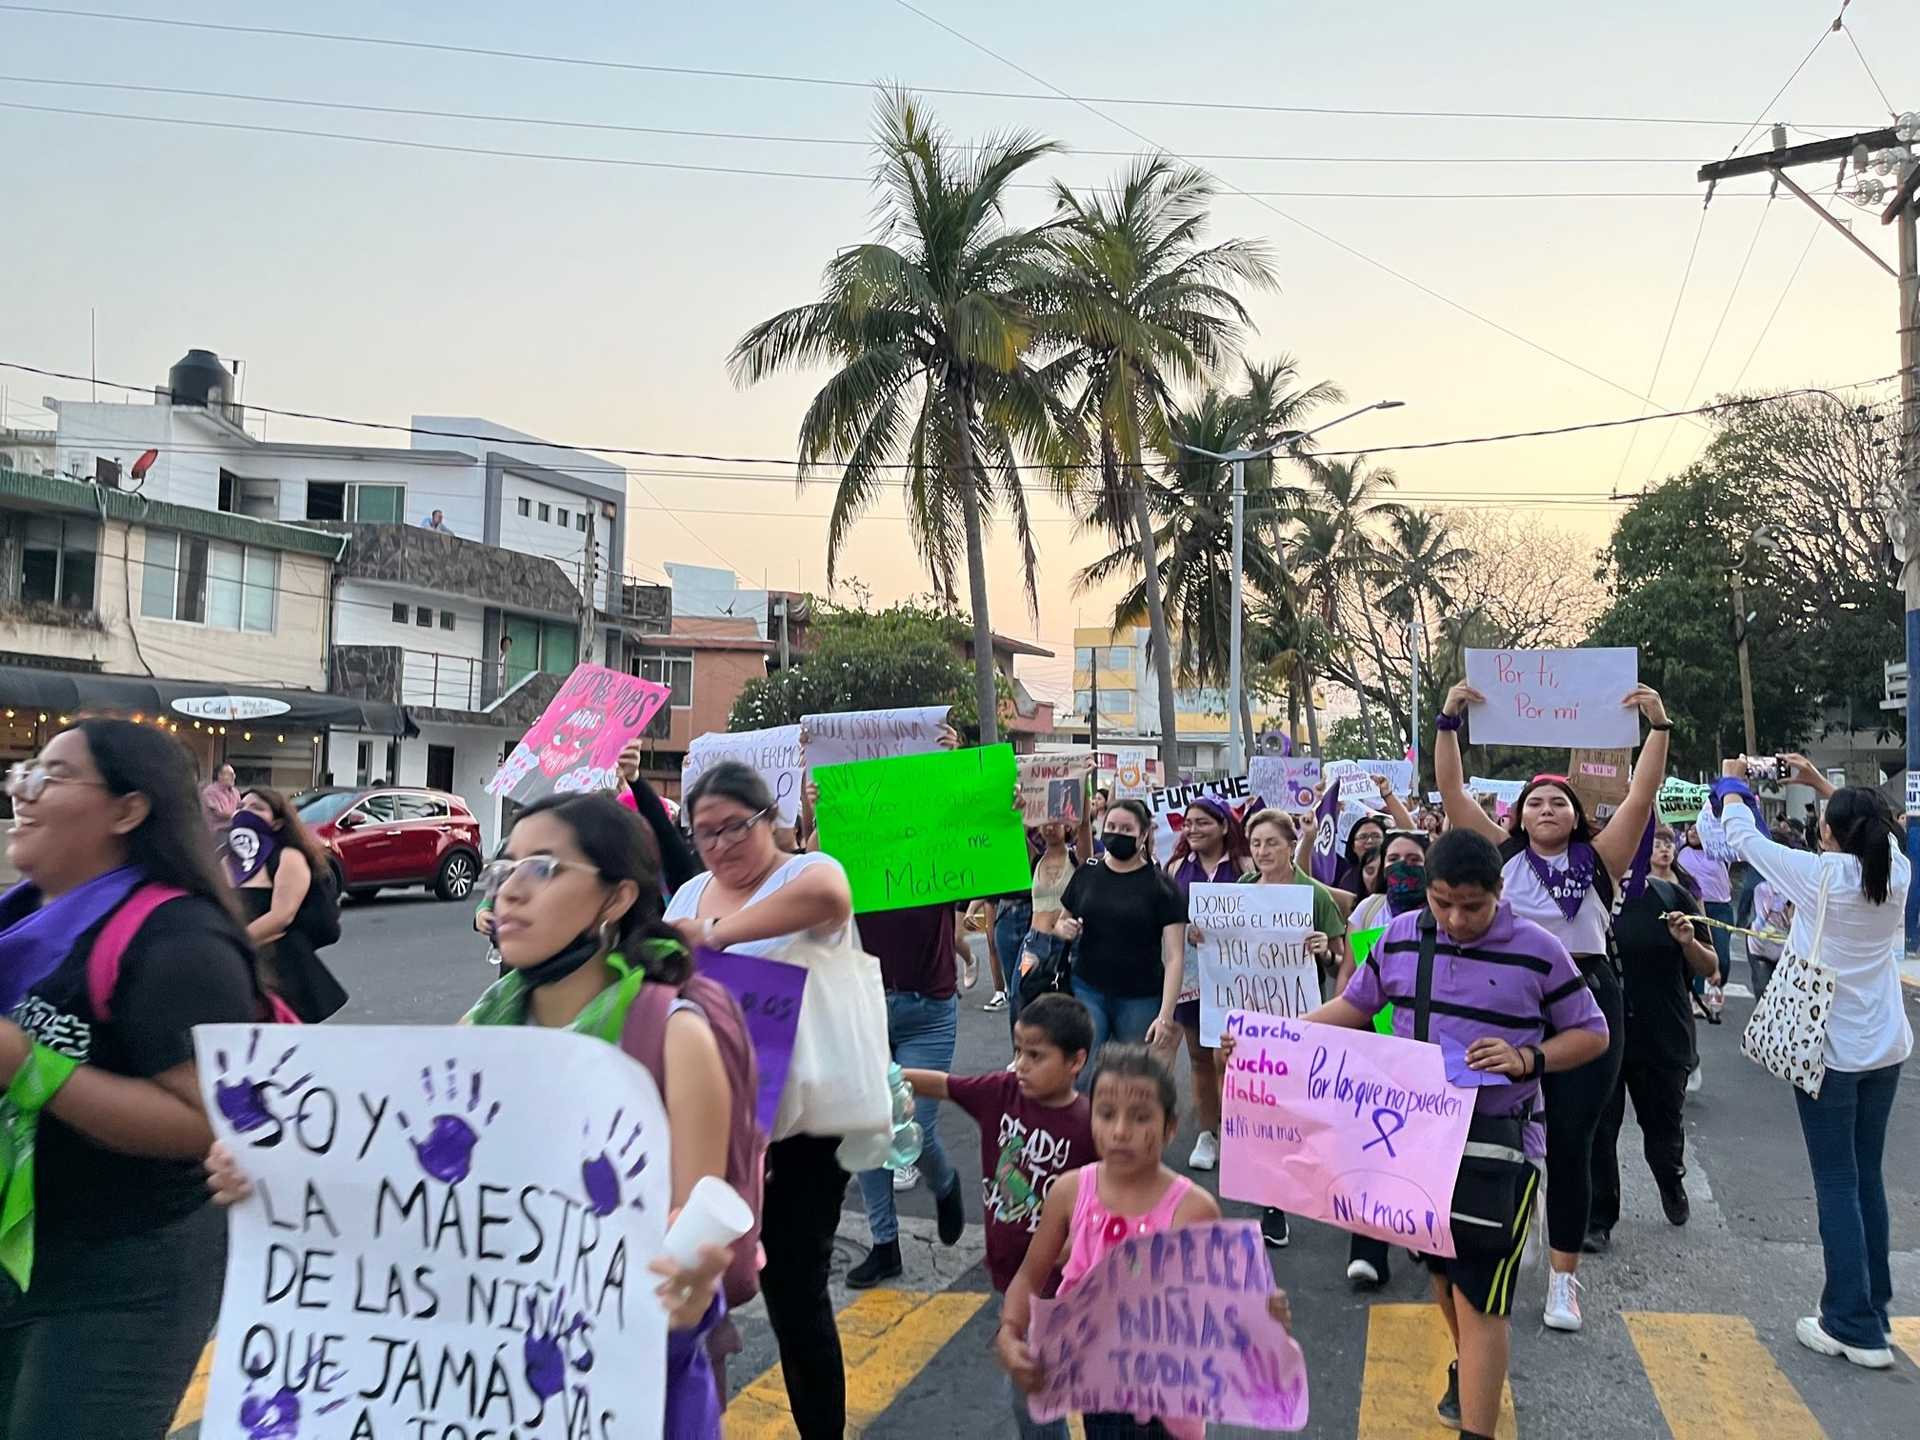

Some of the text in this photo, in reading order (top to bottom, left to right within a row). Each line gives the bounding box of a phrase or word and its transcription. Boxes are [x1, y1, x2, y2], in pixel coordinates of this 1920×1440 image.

[1494, 653, 1524, 683] Por
[1515, 692, 1544, 719] Por
[1151, 782, 1206, 813] FUCK
[1206, 775, 1250, 801] THE
[884, 861, 976, 902] Maten
[1195, 895, 1246, 915] DONDE
[1250, 916, 1267, 929] EL
[1272, 911, 1312, 928] MIEDO
[1216, 983, 1236, 1008] LA
[1234, 974, 1308, 1018] RABIA
[1307, 1045, 1332, 1101] Por
[1386, 1084, 1406, 1111] no
[1404, 1088, 1463, 1122] pueden
[256, 1175, 627, 1331] LA MAESTRA
[266, 1243, 336, 1308] DE
[353, 1255, 438, 1319] LAS
[1117, 1286, 1249, 1352] NIÑAS
[240, 1323, 345, 1394] QUE
